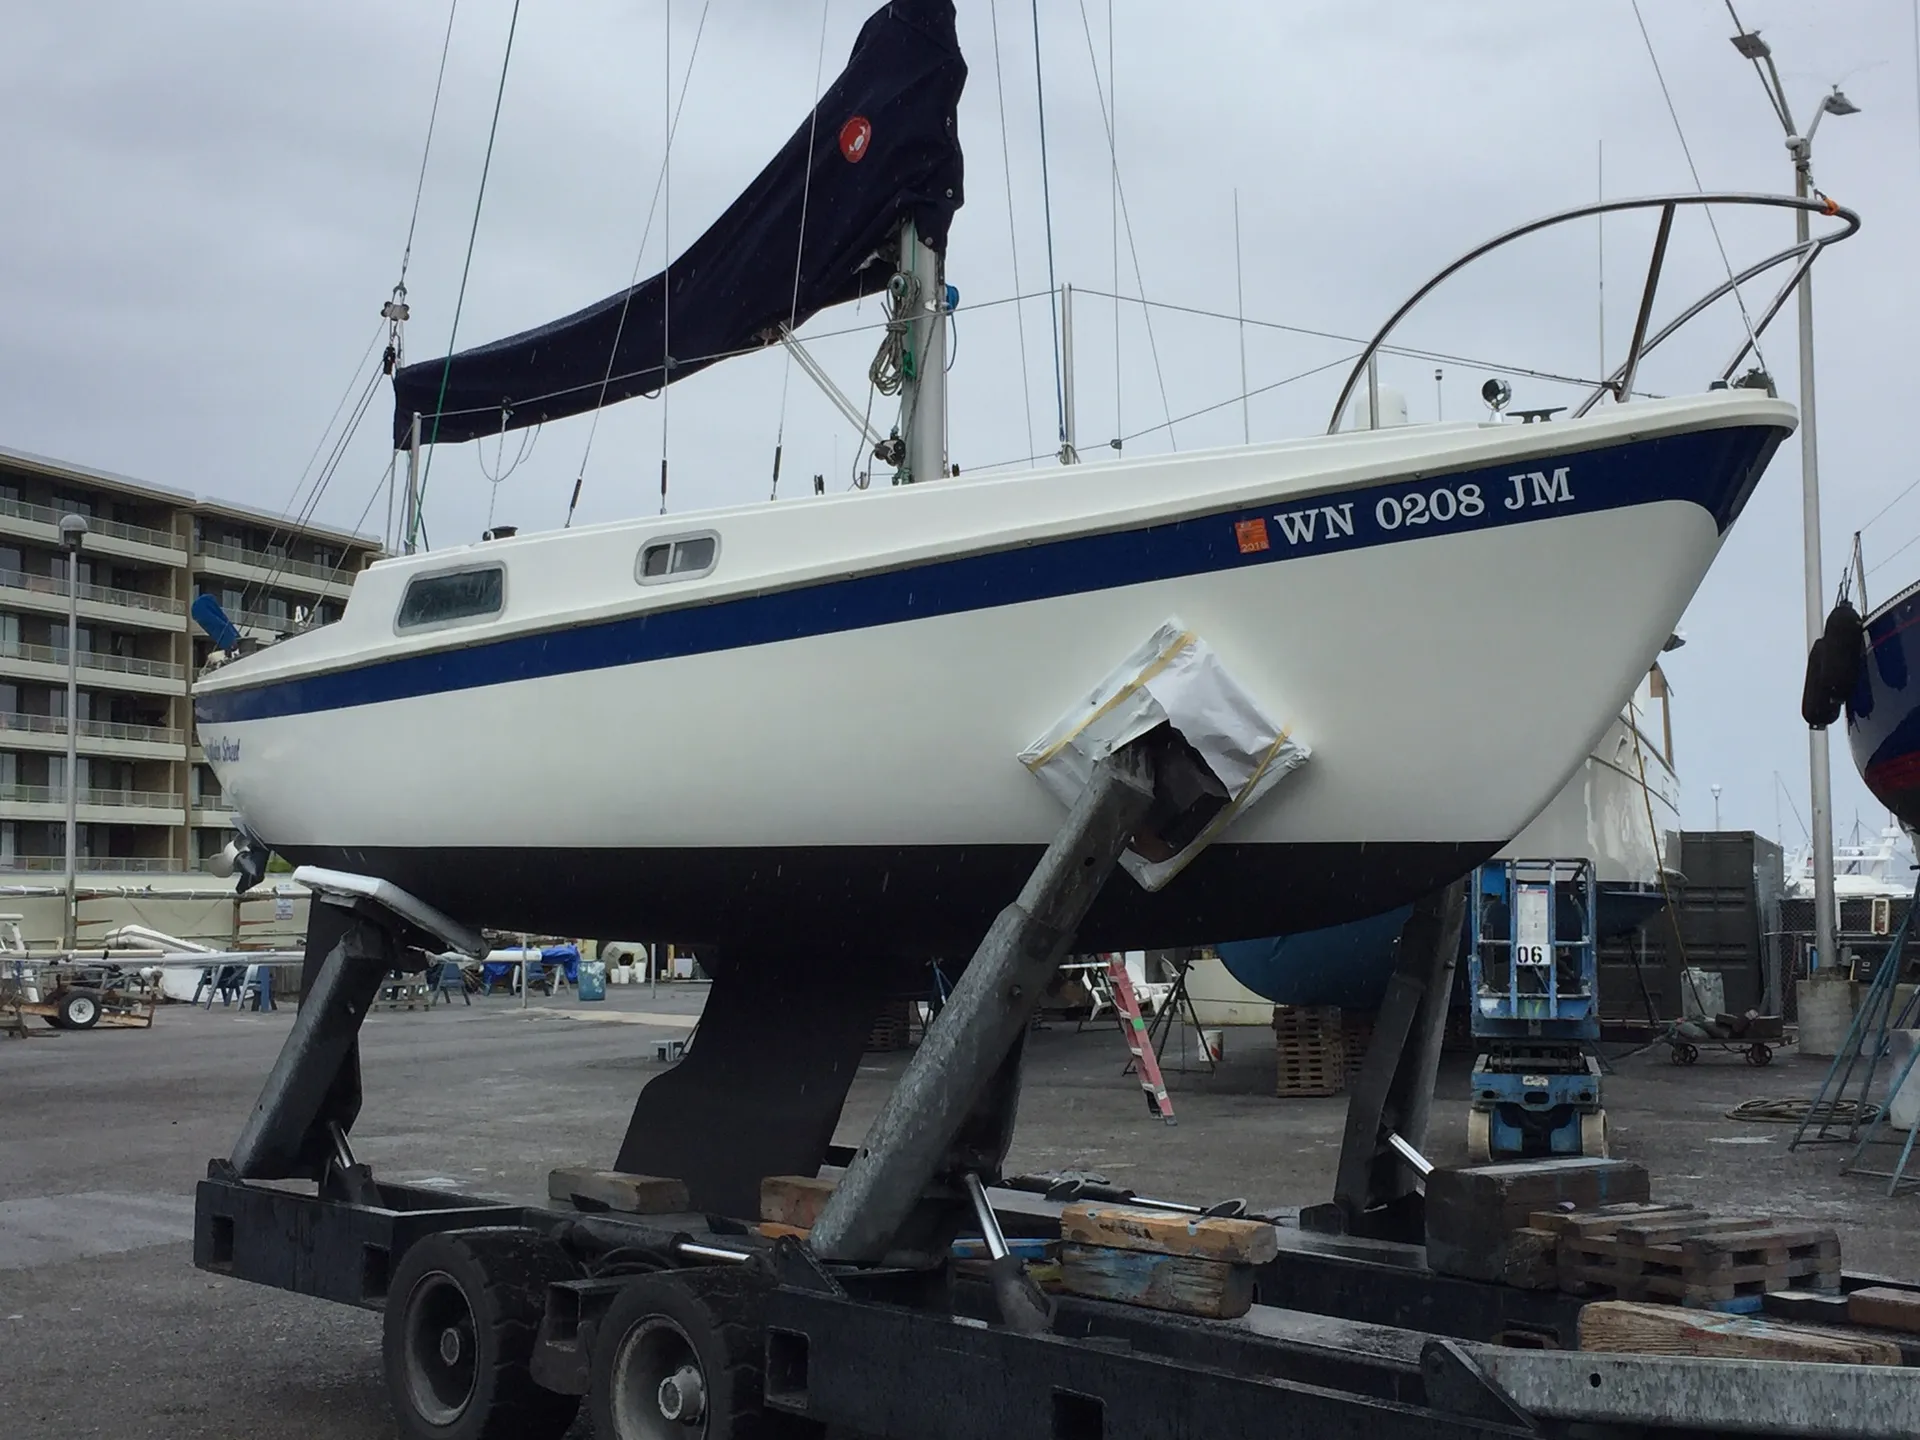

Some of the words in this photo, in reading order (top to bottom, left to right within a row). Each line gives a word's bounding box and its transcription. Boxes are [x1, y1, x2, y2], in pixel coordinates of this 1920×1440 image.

[1274, 502, 1355, 545] WN
[1375, 484, 1485, 530] 0208
[1504, 467, 1575, 511] JM
[1517, 945, 1543, 964] 06
